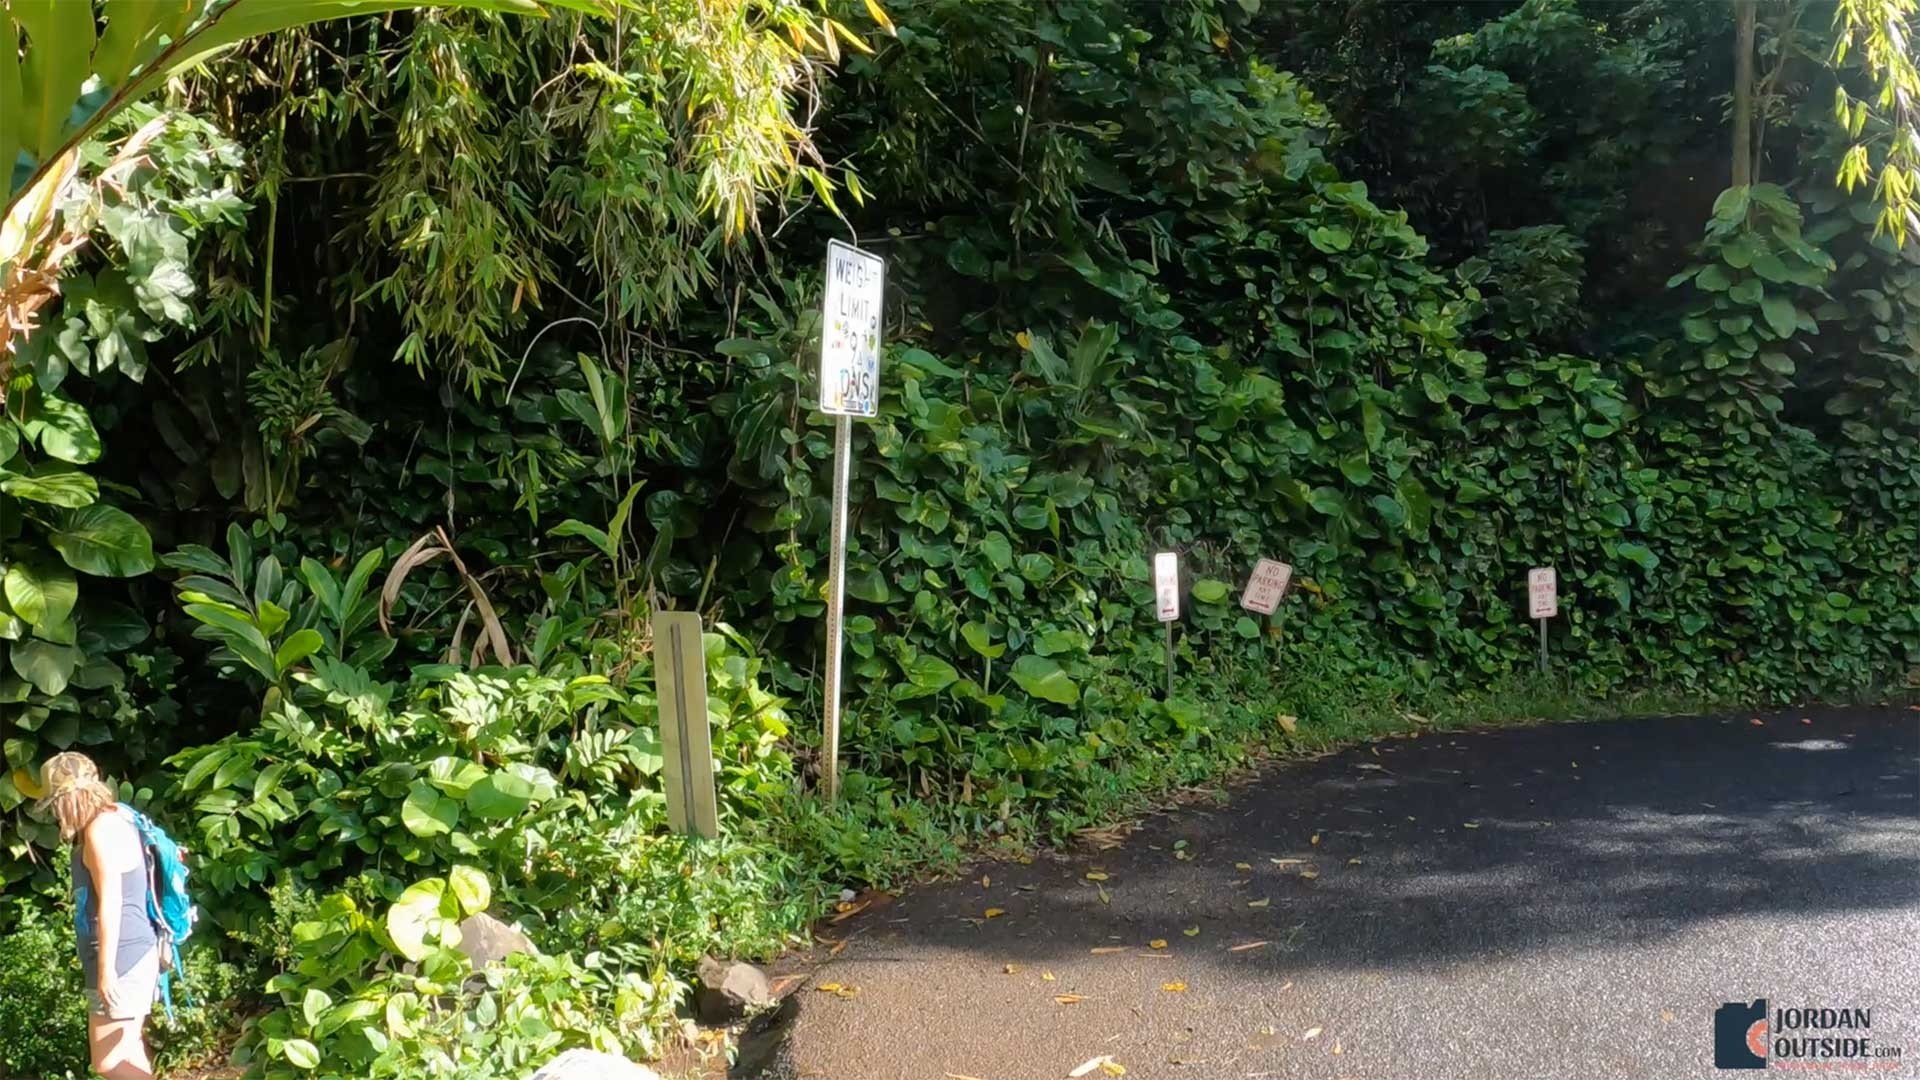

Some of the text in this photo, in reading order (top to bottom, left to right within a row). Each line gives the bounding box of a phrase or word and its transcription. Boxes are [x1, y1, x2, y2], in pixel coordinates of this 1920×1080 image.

[835, 256, 878, 289] WEIGH
[840, 291, 870, 322] LIMIT
[838, 366, 870, 400] ONS
[1265, 565, 1280, 577] NO
